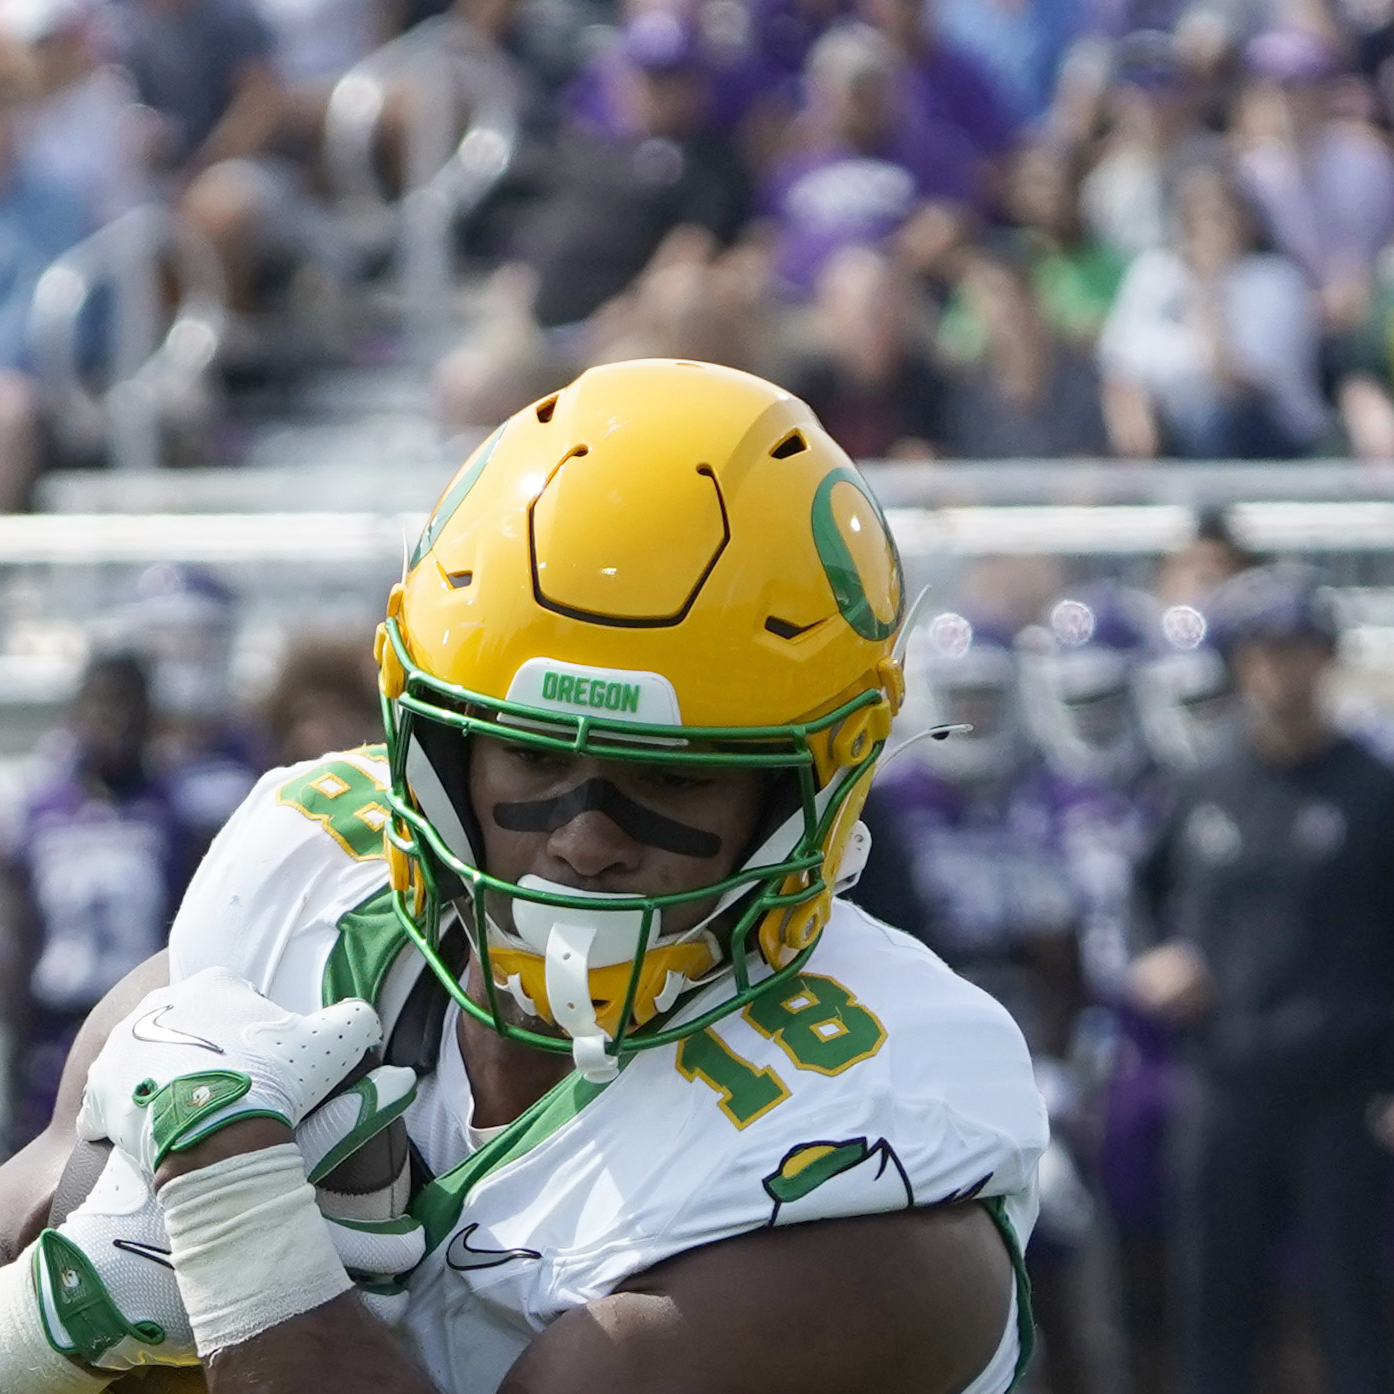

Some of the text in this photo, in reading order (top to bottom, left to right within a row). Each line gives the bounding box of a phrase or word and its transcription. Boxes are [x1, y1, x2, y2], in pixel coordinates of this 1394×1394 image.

[542, 670, 640, 714] OREGON
[276, 743, 388, 862] 8
[675, 971, 888, 1131] 18
